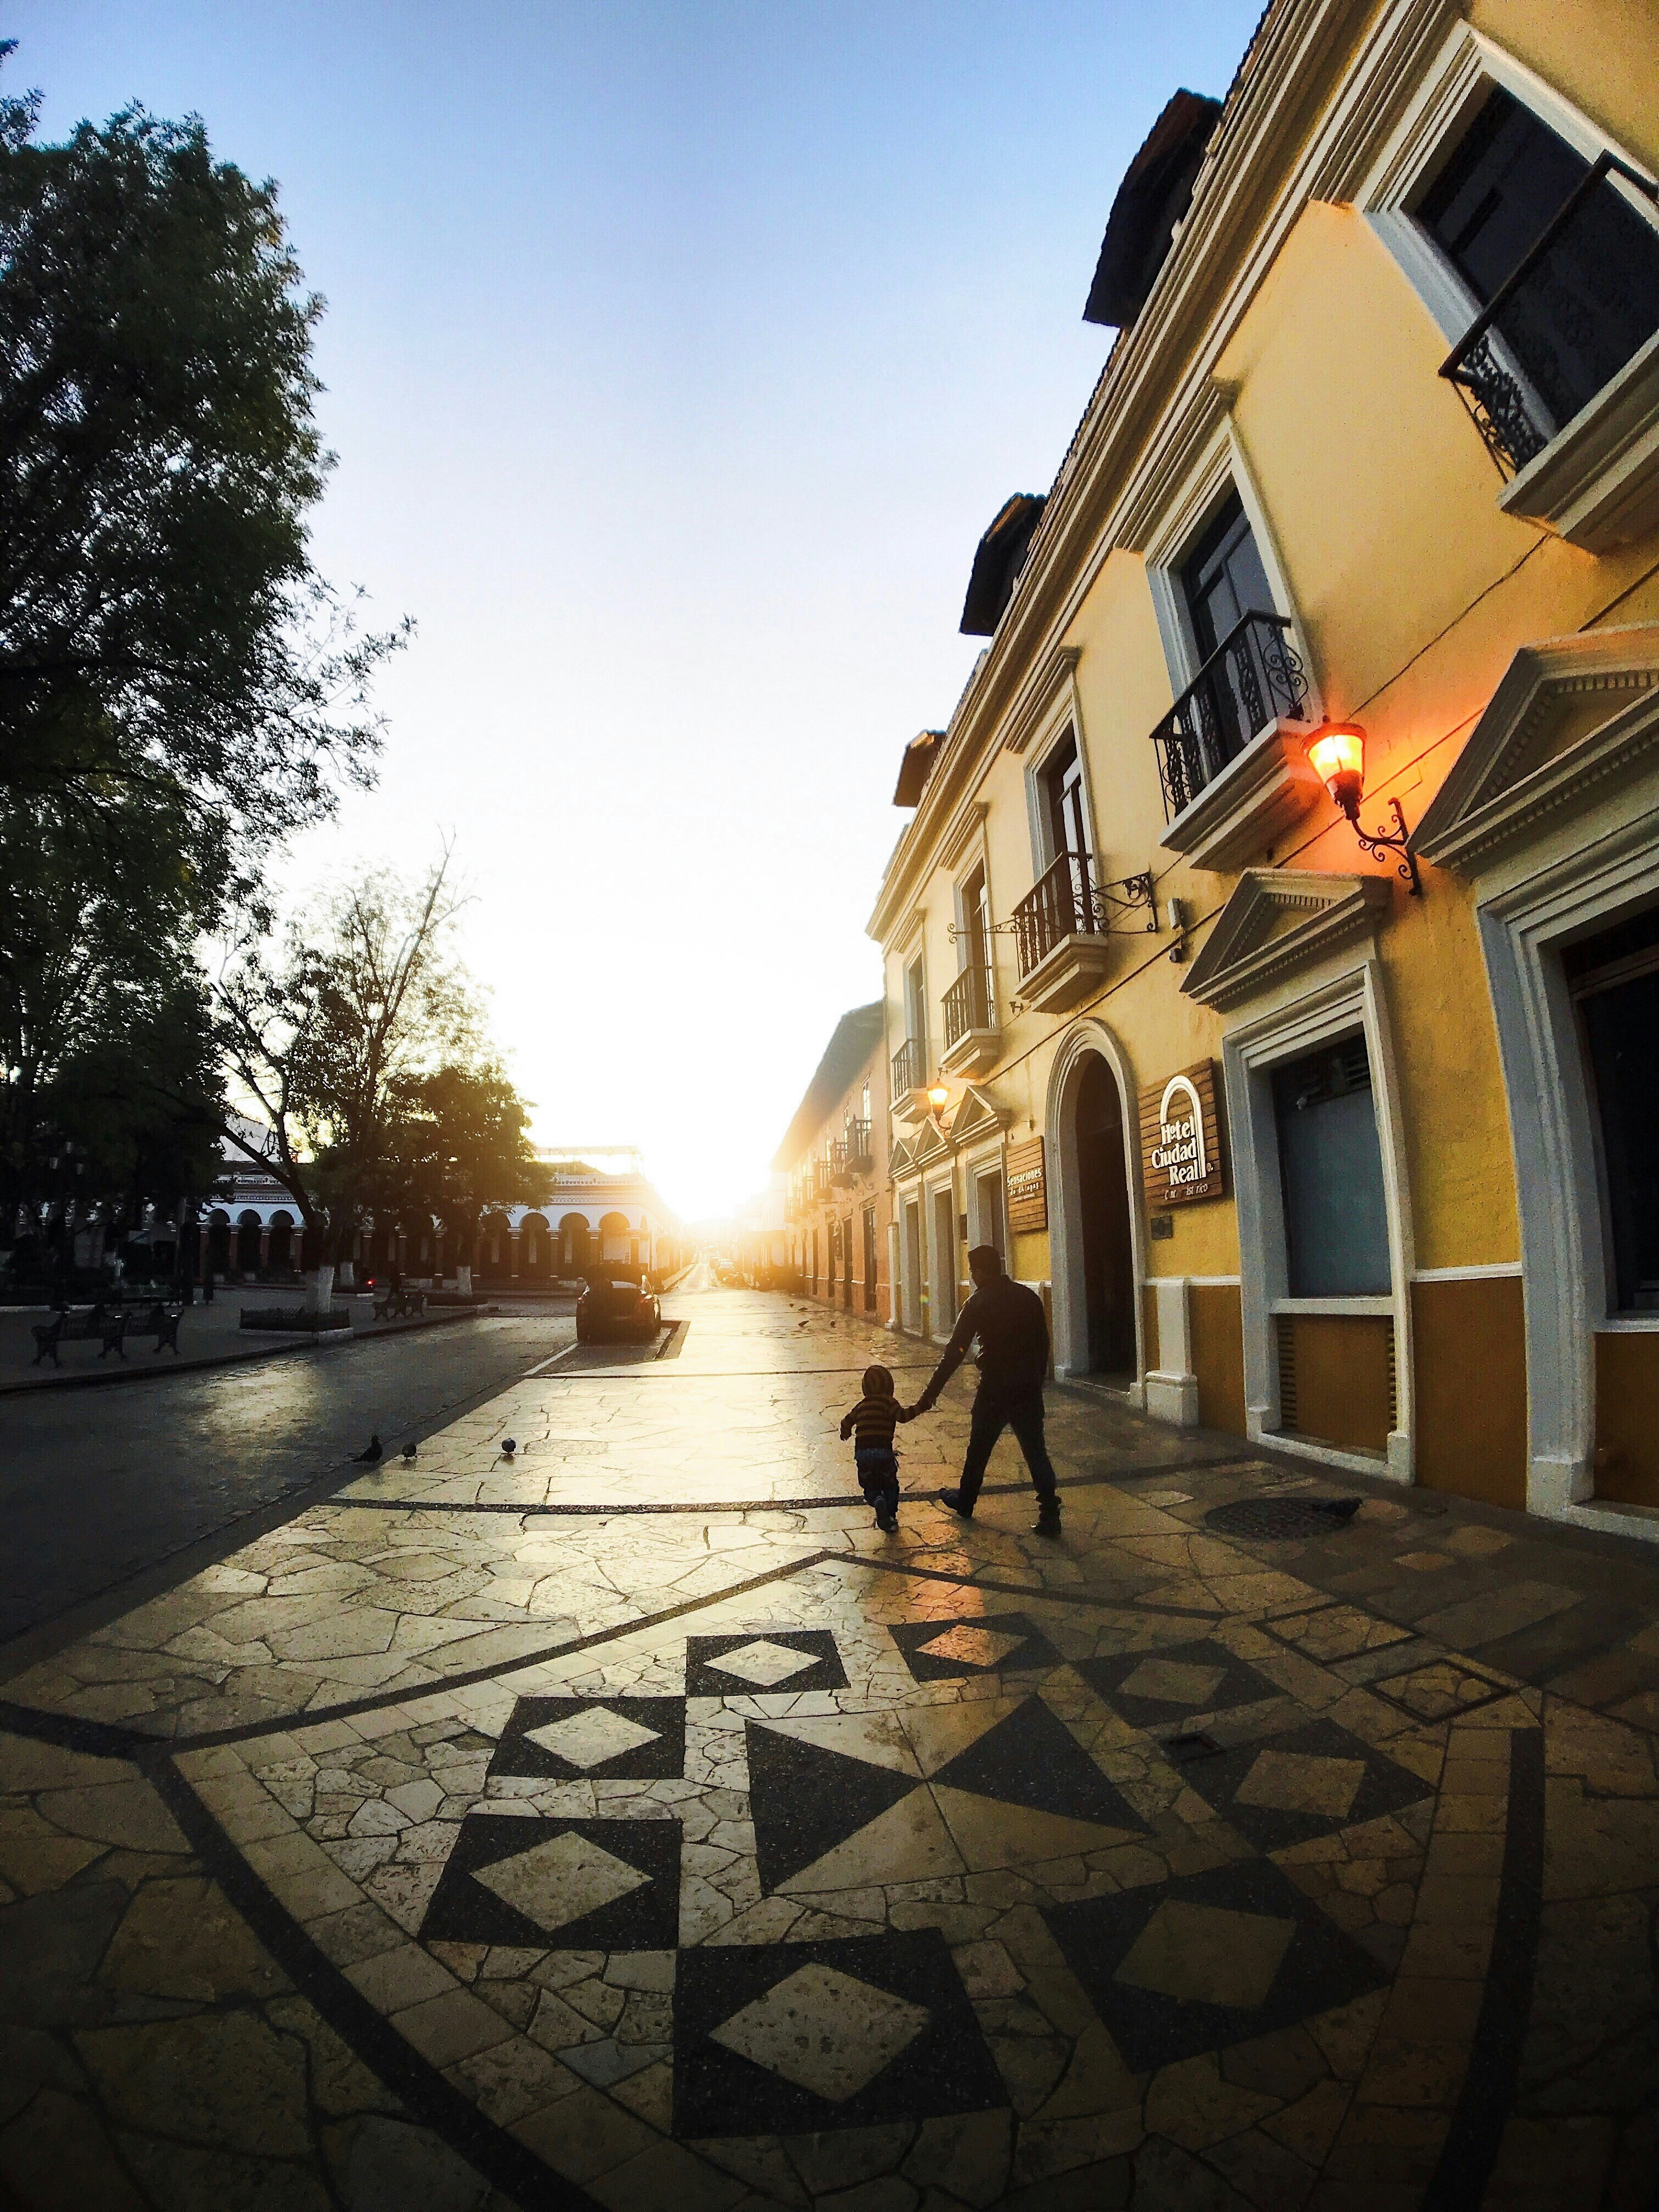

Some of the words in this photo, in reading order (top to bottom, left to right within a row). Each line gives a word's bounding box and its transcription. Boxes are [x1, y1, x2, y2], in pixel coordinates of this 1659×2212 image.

[1161, 1115, 1195, 1145] Hotel
[1152, 1137, 1197, 1169] Ciudad
[1007, 1167, 1042, 1187] Sensaciones
[1169, 1160, 1198, 1186] Real
